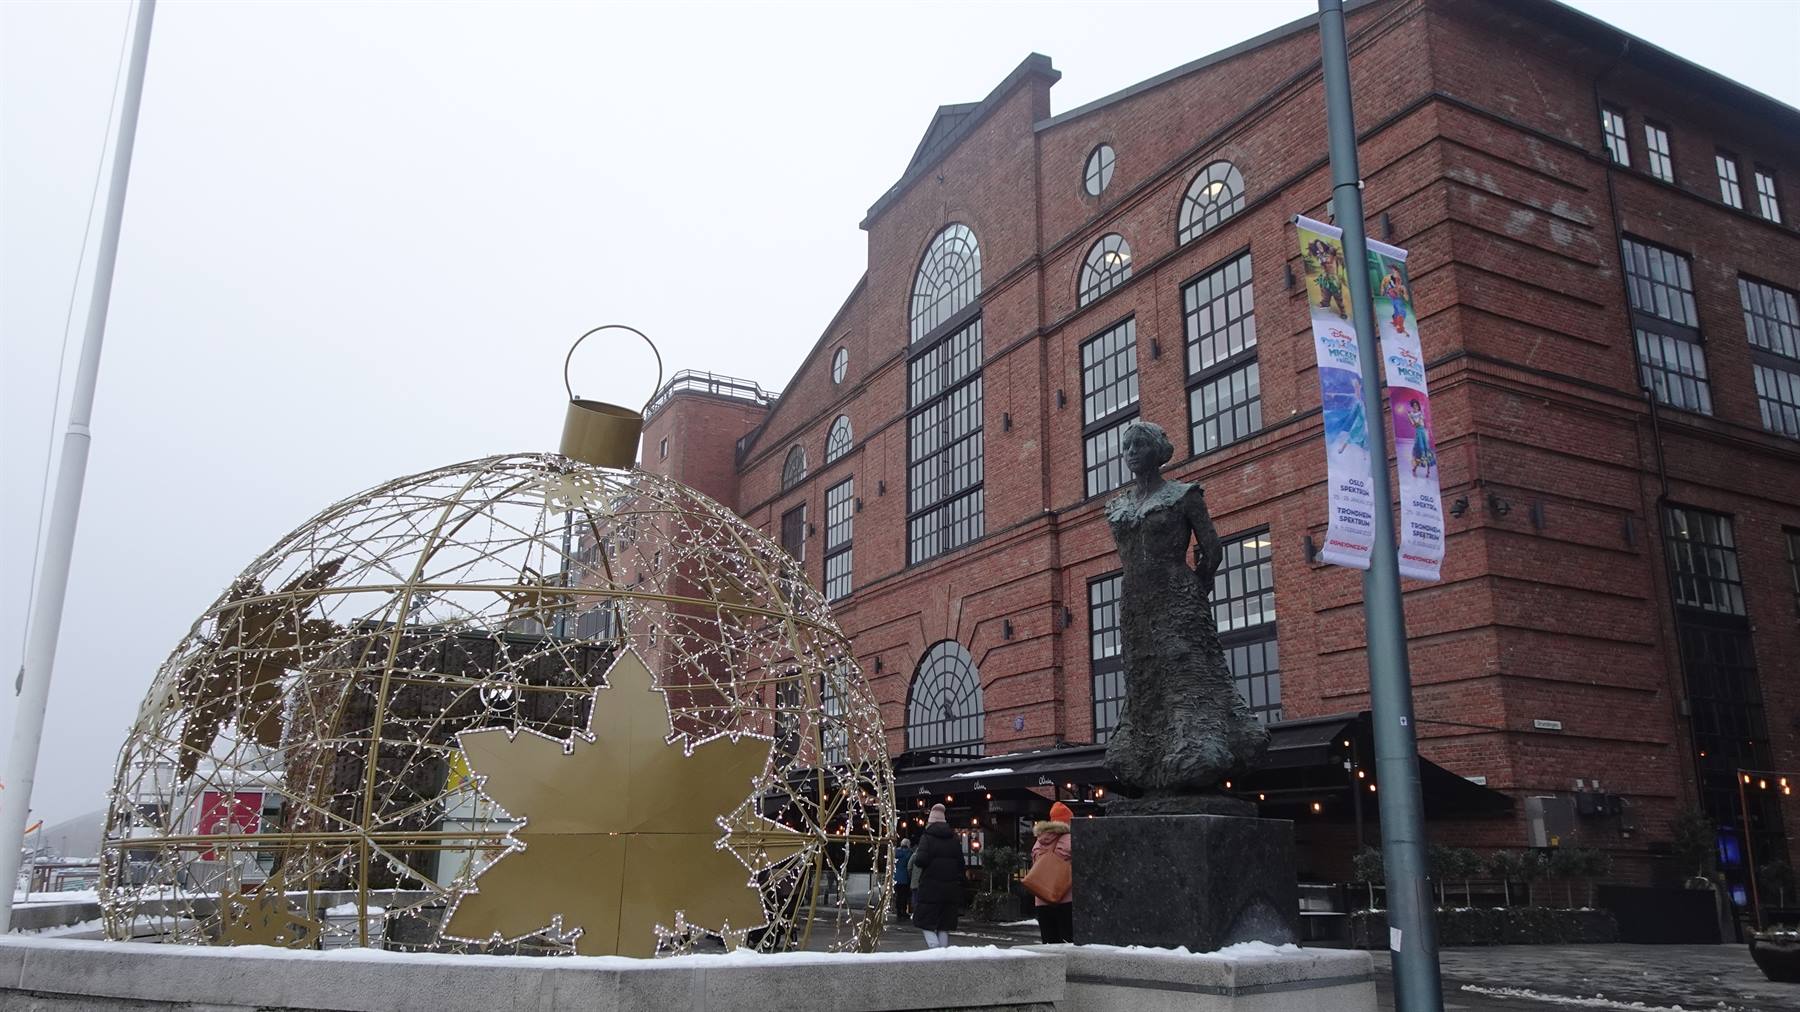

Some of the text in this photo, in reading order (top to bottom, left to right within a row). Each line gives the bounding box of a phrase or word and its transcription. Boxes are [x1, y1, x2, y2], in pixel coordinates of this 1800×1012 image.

[1349, 479, 1364, 487] OSLO
[1340, 485, 1369, 496] SPEKTRUM
[1420, 494, 1434, 503] OSLO
[1337, 507, 1371, 518] TRONDHEIM
[1339, 516, 1370, 527] SPEKTRUM
[1412, 530, 1439, 540] SPEKTRUM
